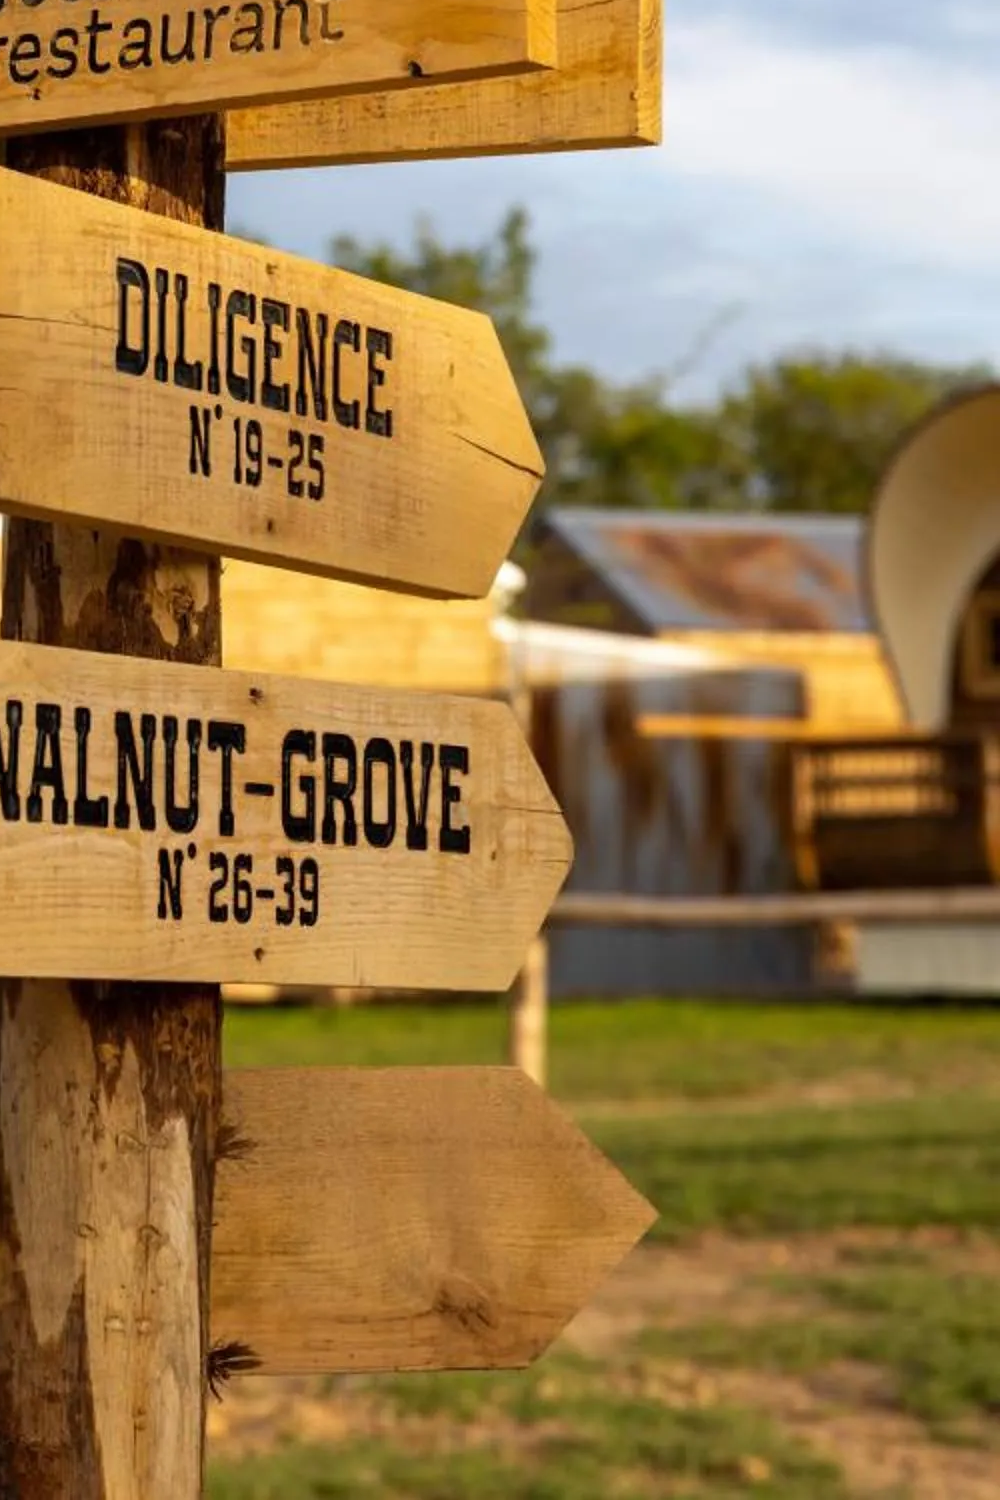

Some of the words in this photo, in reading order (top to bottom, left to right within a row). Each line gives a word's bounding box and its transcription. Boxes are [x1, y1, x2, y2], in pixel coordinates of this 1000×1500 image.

[115, 256, 394, 439] DILIGENCE
[232, 416, 325, 501] 19-25
[208, 851, 320, 927] 26-39
